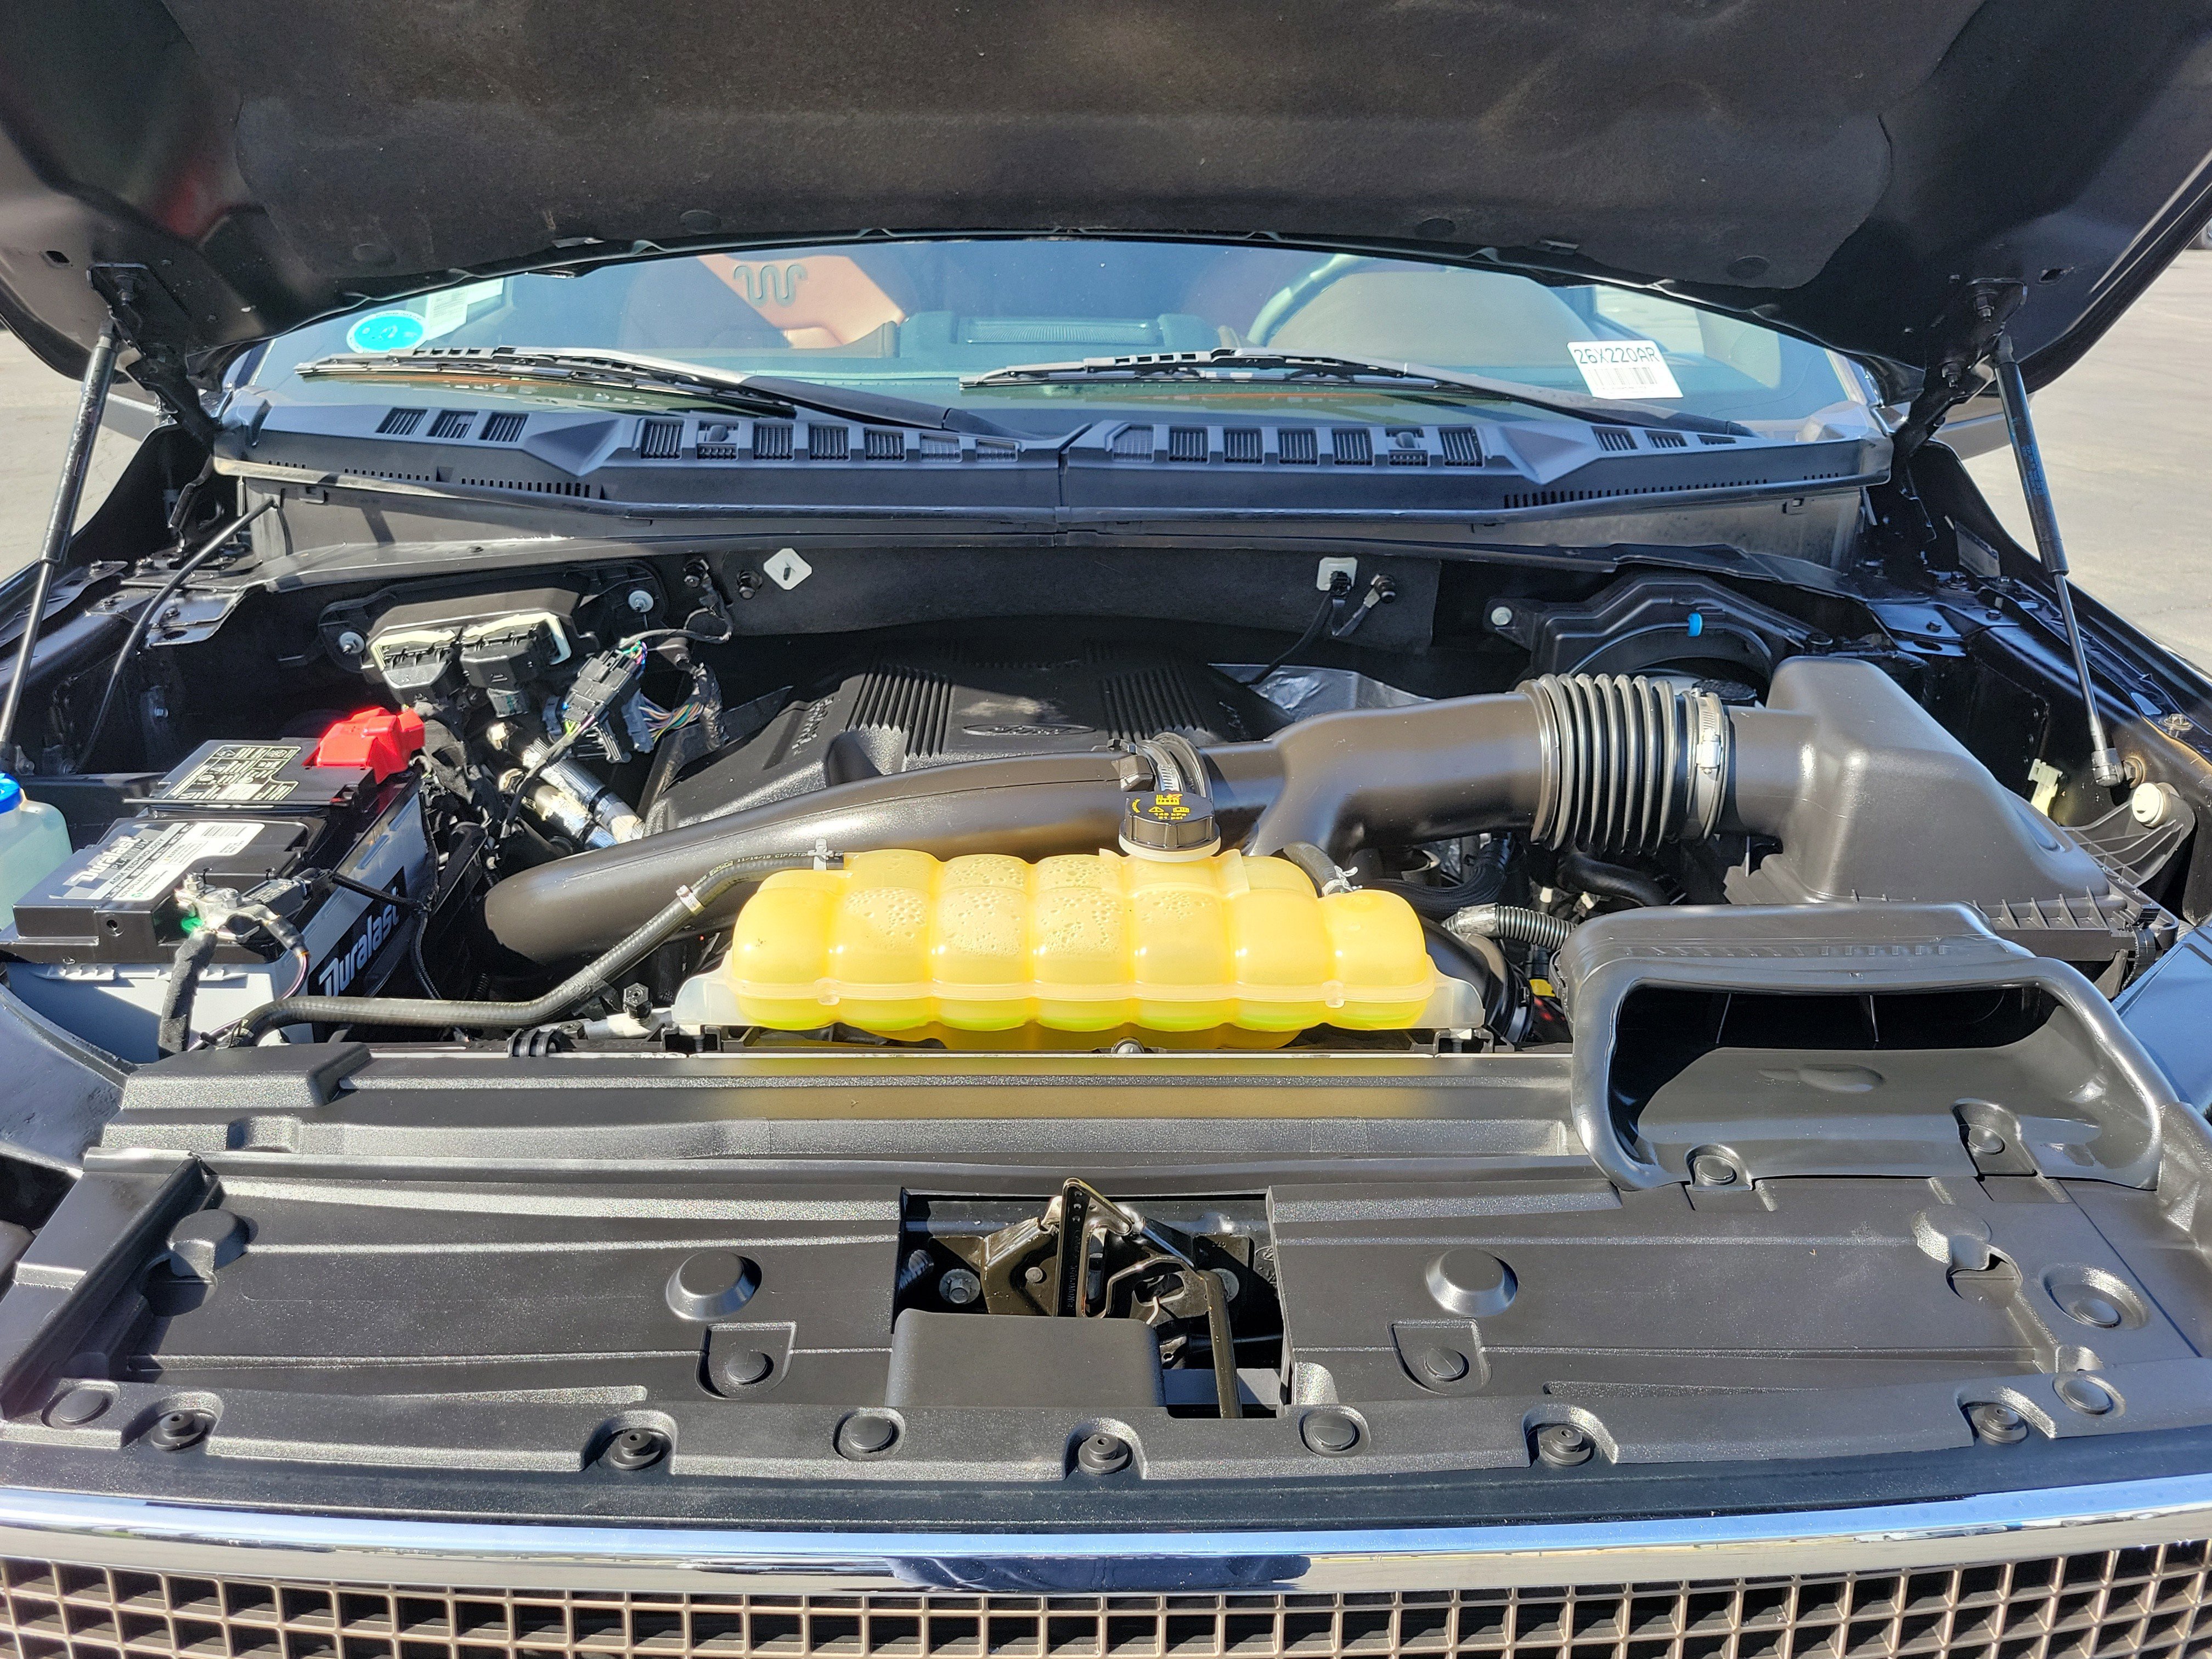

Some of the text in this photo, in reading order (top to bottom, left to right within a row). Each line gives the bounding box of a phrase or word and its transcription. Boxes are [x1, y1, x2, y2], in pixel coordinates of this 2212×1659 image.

[1574, 347, 1660, 364] 26X220AR
[70, 836, 142, 882] Duralast
[110, 872, 127, 885] AGM
[125, 838, 165, 871] TECHNOLOGY
[111, 838, 153, 870] PLATINUM
[319, 885, 399, 997] Duralast
